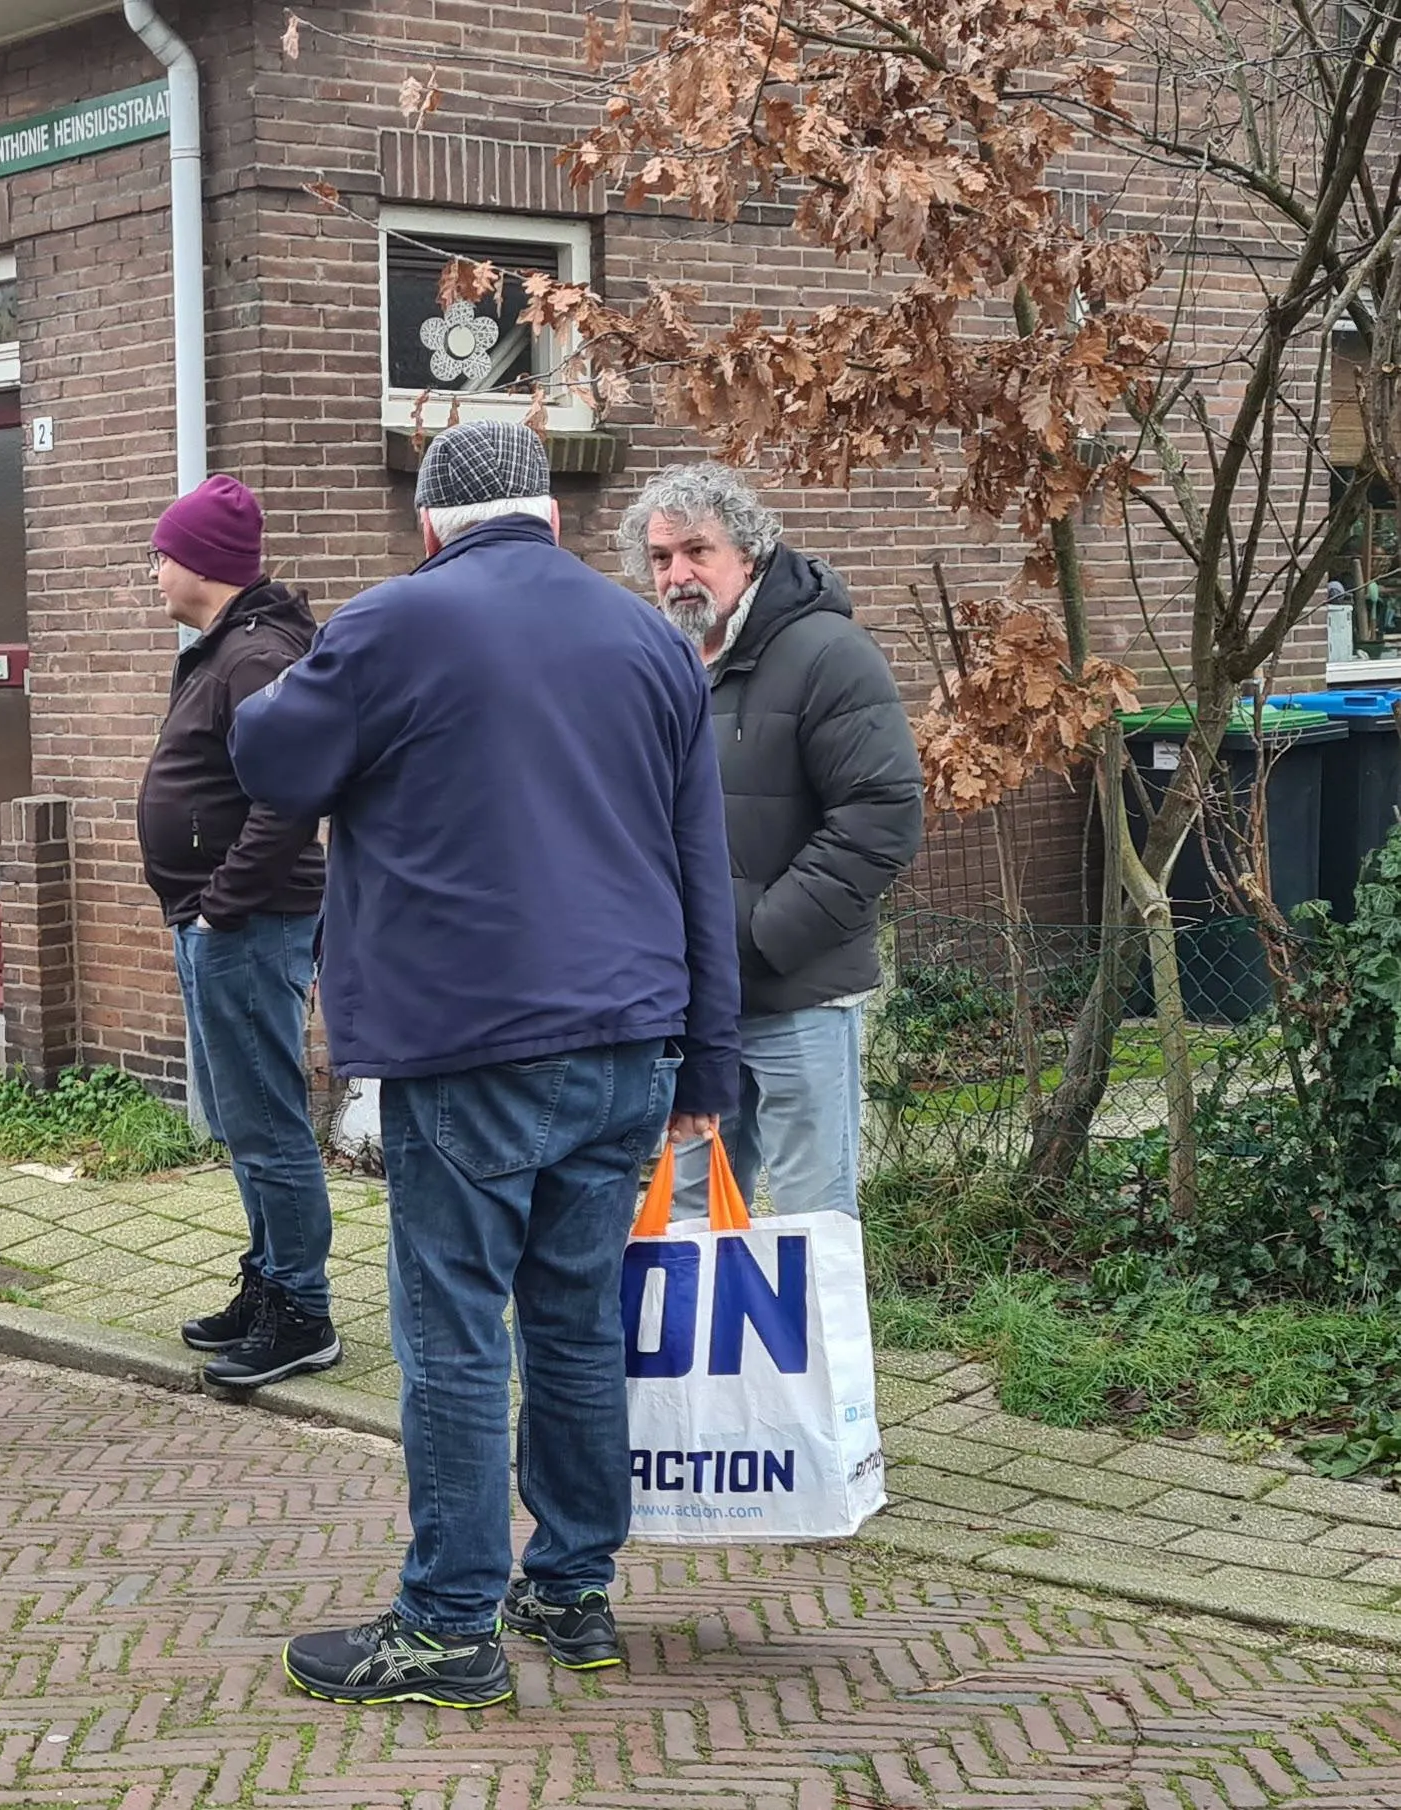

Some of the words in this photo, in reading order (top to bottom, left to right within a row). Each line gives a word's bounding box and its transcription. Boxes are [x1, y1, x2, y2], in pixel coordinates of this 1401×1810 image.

[54, 90, 171, 148] HEINSIUSSTRAAT
[39, 423, 45, 444] 2
[630, 1449, 795, 1493] ACTION
